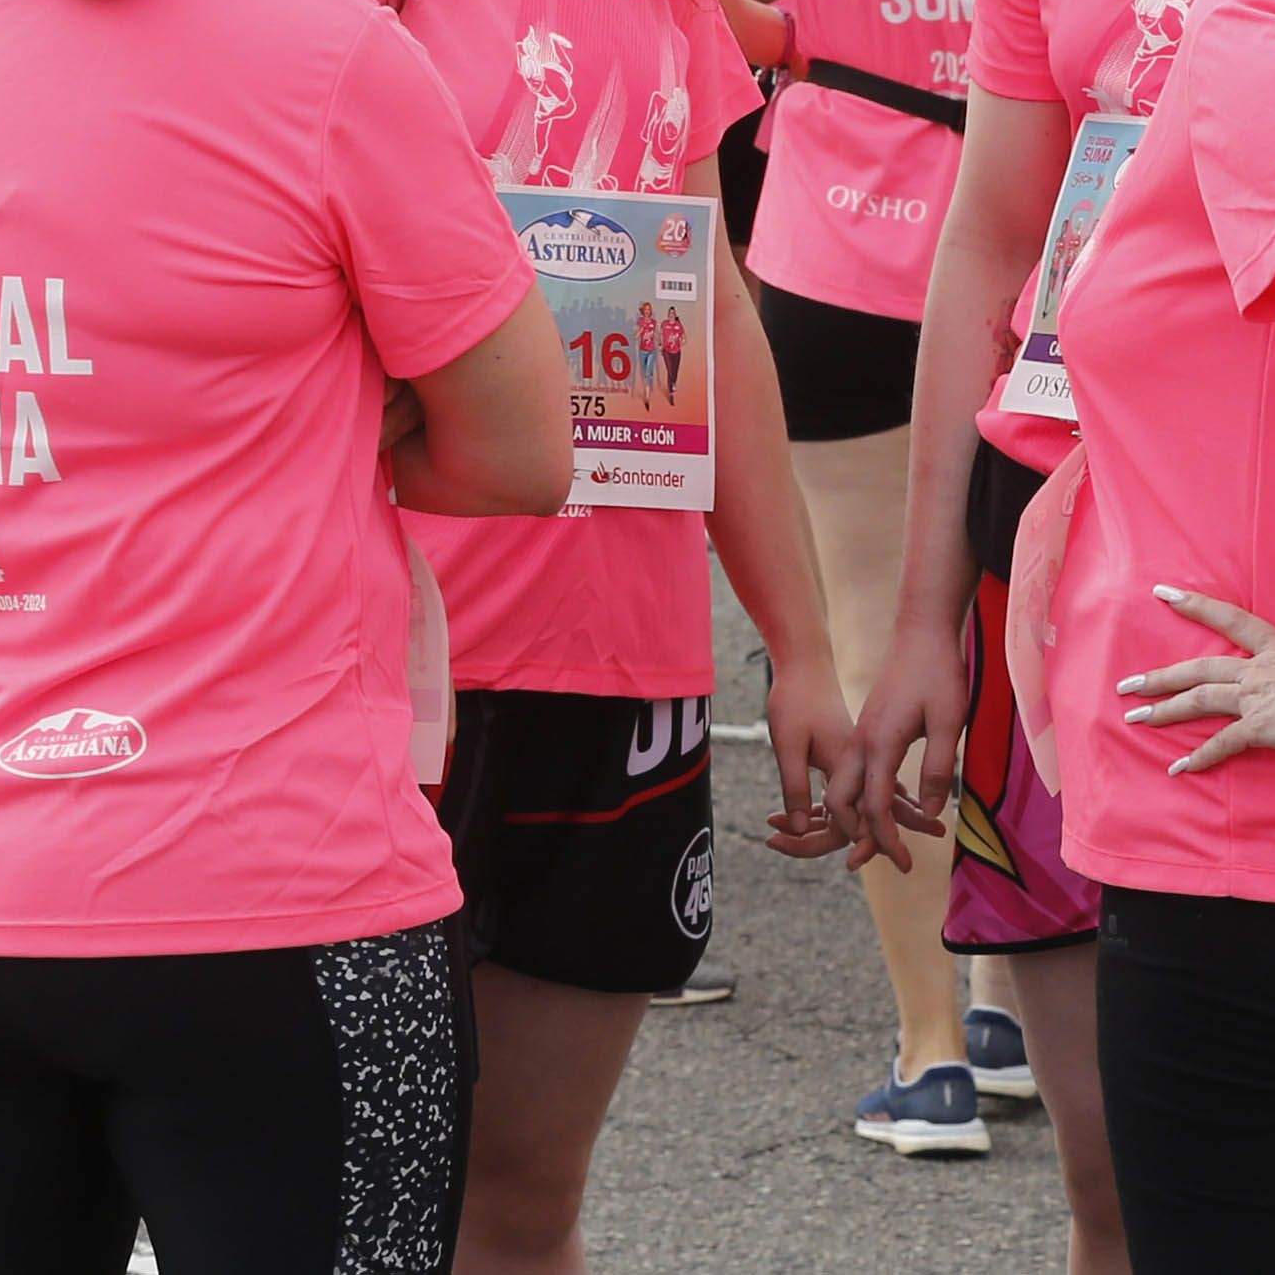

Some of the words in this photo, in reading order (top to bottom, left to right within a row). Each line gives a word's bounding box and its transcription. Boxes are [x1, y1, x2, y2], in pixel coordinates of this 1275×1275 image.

[826, 183, 927, 224] OYSHO
[662, 219, 687, 242] 20
[587, 425, 632, 443] MUJER
[641, 424, 675, 446] GIJÓN
[613, 466, 686, 489] Santander
